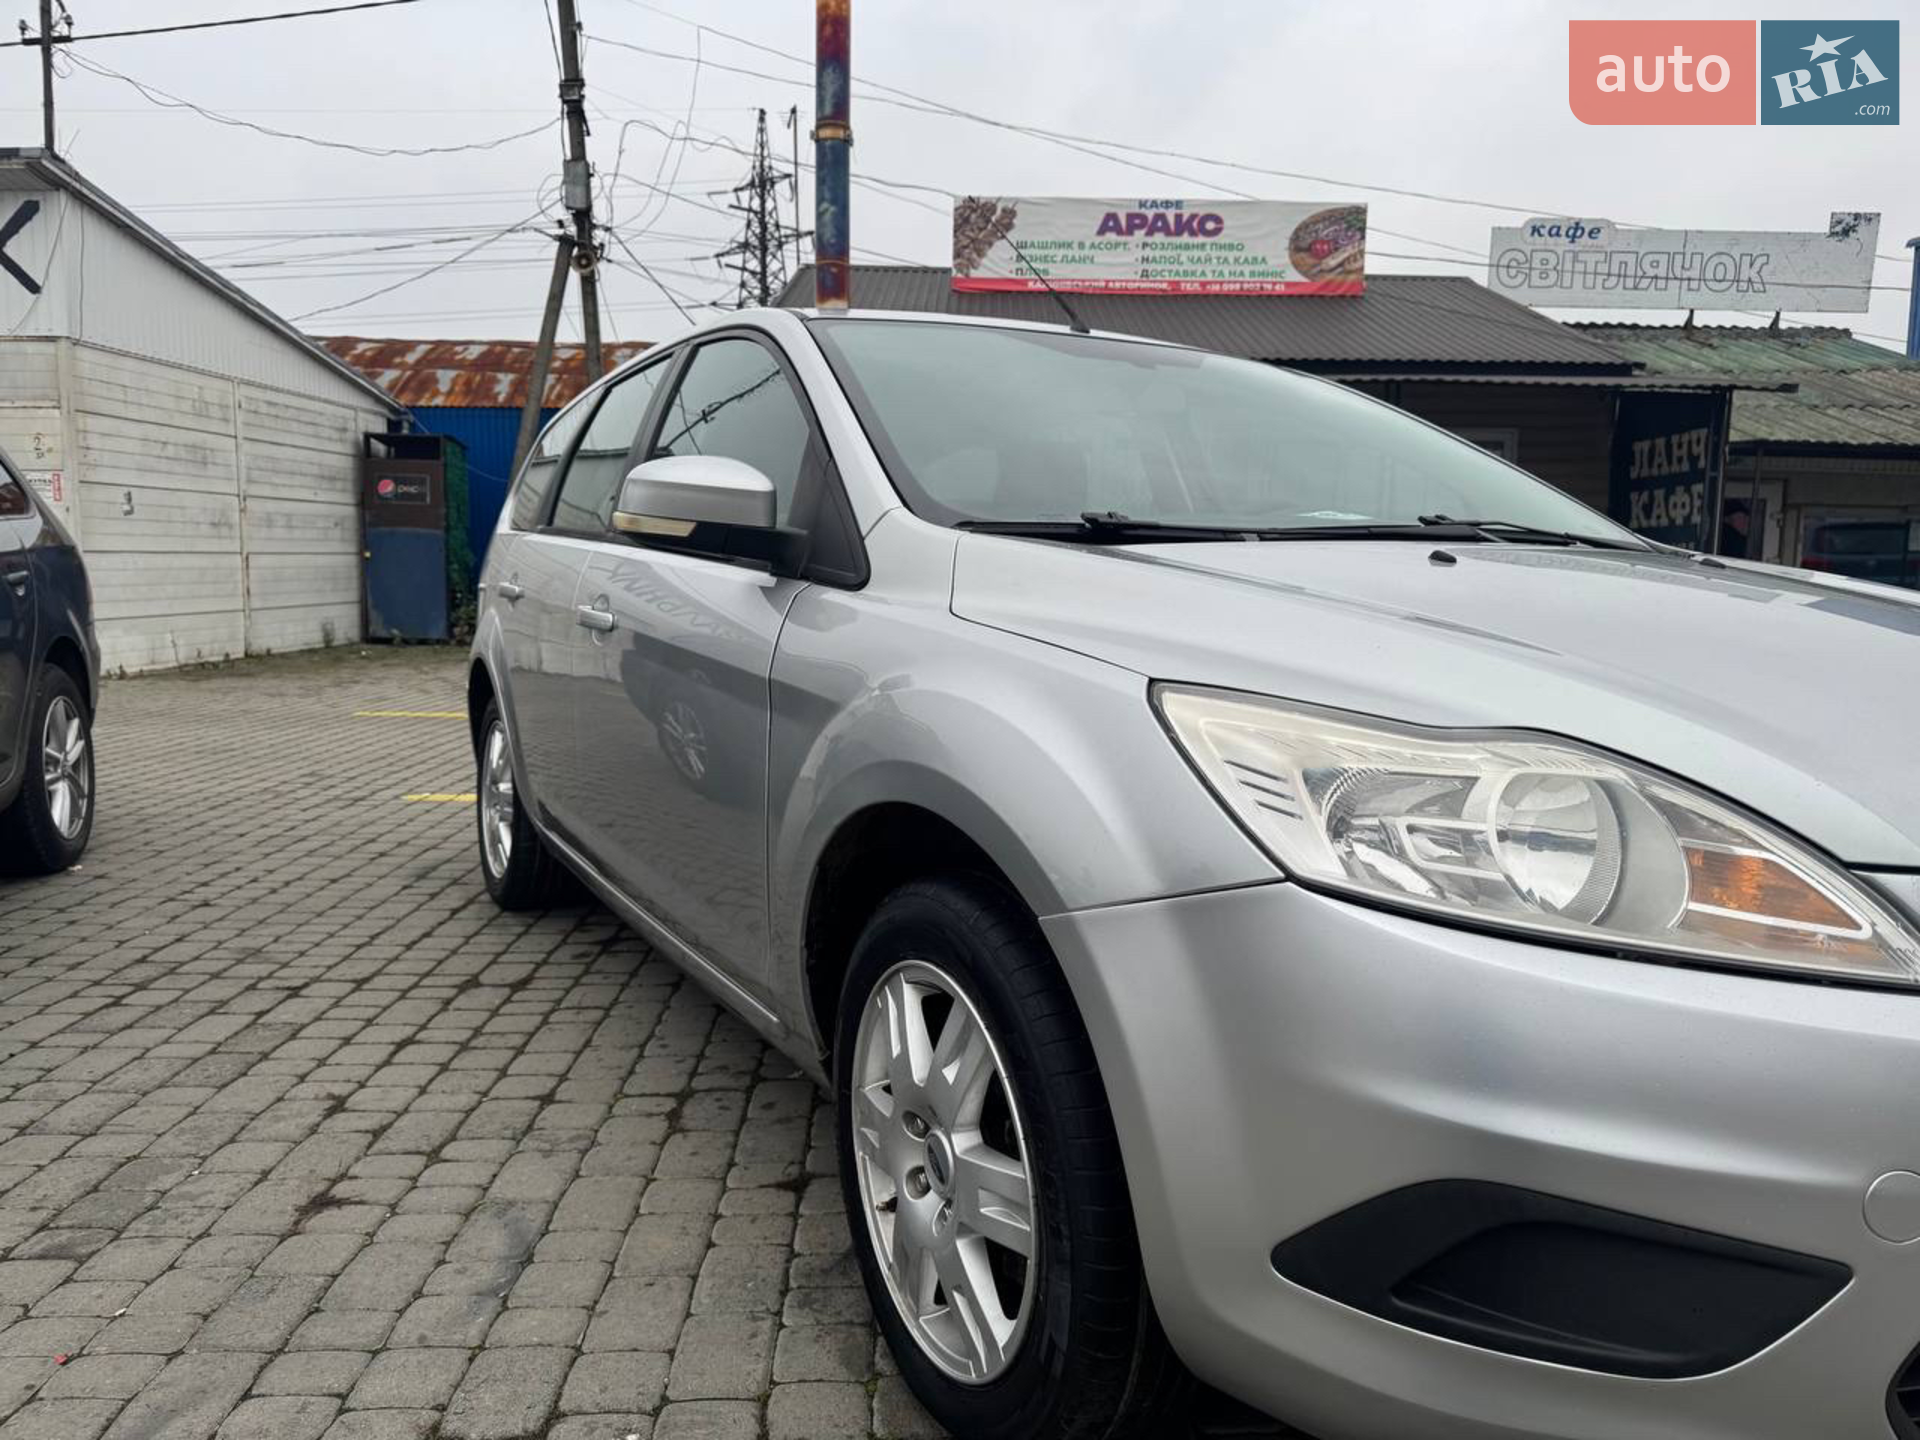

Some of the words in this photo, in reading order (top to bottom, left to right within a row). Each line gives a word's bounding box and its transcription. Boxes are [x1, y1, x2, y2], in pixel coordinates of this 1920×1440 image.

[1138, 200, 1184, 210] КАФЕ
[1096, 212, 1224, 237] АРАКС
[1529, 221, 1602, 245] кафе
[1015, 240, 1074, 250] ШАШЛИК
[1078, 241, 1086, 250] В
[1089, 241, 1131, 251] АСОРТ.
[1141, 242, 1208, 251] РОЗЛИВНЕ
[1210, 242, 1245, 252] ПИВО
[1015, 254, 1057, 264] БЗНЕС
[1060, 254, 1095, 264] ЛАНЧ
[1187, 253, 1212, 264] ЧАЙ
[1215, 255, 1230, 264] ТА
[1233, 255, 1268, 265] КАВА
[1140, 269, 1206, 279] ДОСТАВКА
[1211, 270, 1225, 279] ТА
[1228, 270, 1245, 279] НА
[1248, 270, 1286, 279] ВИНІС
[1496, 248, 1769, 293] СВІТЛЯЧОК
[1630, 427, 1708, 480] ЛАНЧ
[1630, 482, 1704, 529] КАФЕ
